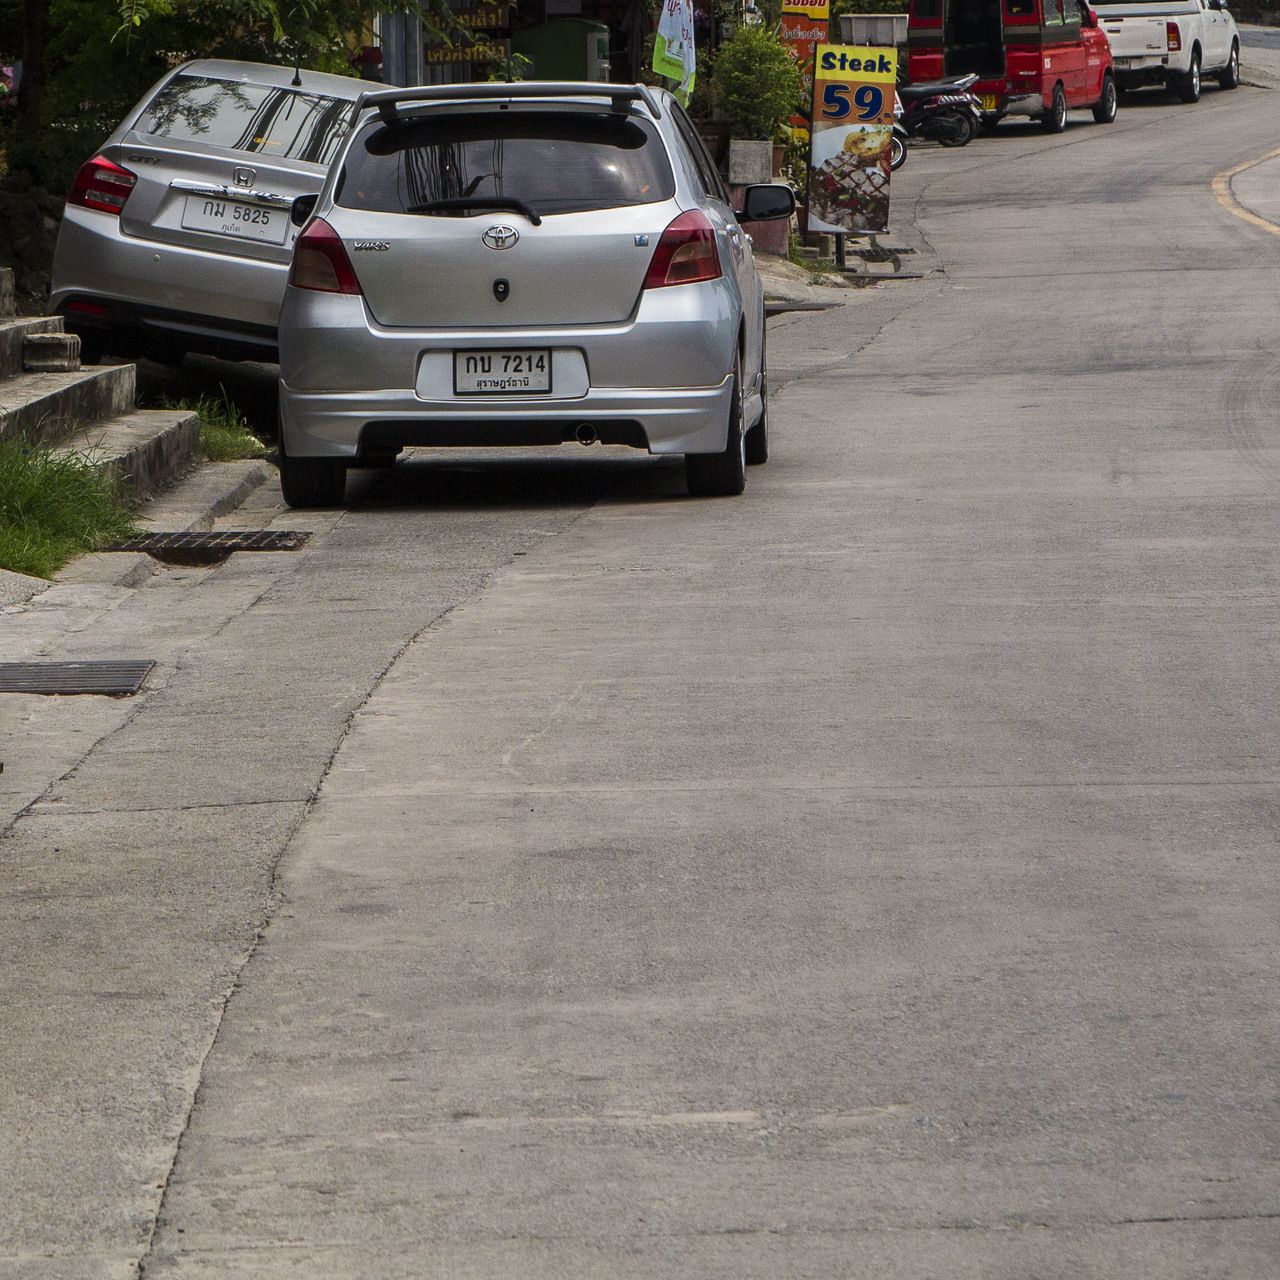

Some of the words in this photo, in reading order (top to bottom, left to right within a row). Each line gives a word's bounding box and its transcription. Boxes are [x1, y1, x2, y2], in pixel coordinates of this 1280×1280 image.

[821, 51, 892, 74] Steak
[202, 199, 226, 218] กม
[232, 204, 272, 226] 5825
[465, 354, 492, 375] กบ
[501, 354, 546, 374] 7214
[476, 376, 530, 390] สุราษฎร์ธานี
